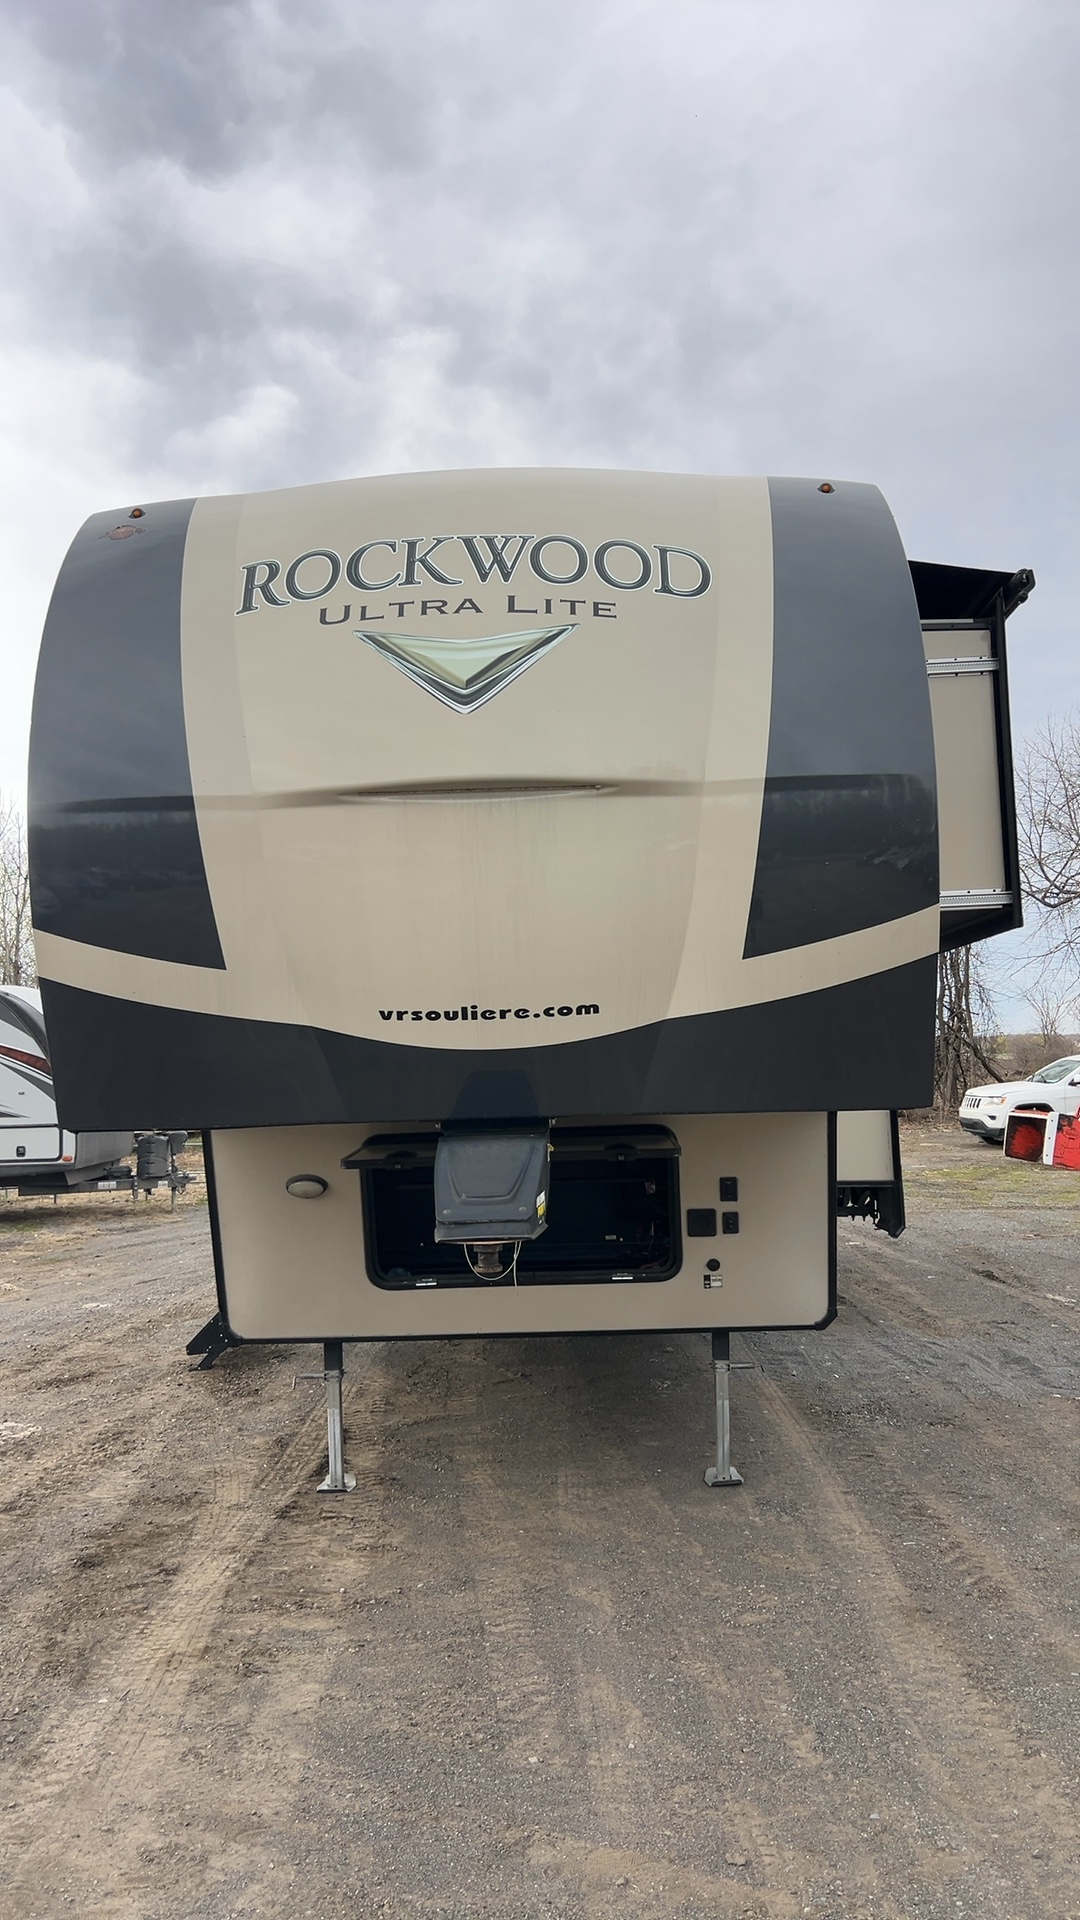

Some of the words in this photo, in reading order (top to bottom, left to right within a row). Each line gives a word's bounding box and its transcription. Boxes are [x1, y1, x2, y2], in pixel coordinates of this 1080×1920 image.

[235, 534, 712, 616] ROCKWOOD
[318, 597, 485, 626] ULTRA
[506, 594, 618, 619] LITE
[378, 1003, 600, 1021] vrsouliere.com
